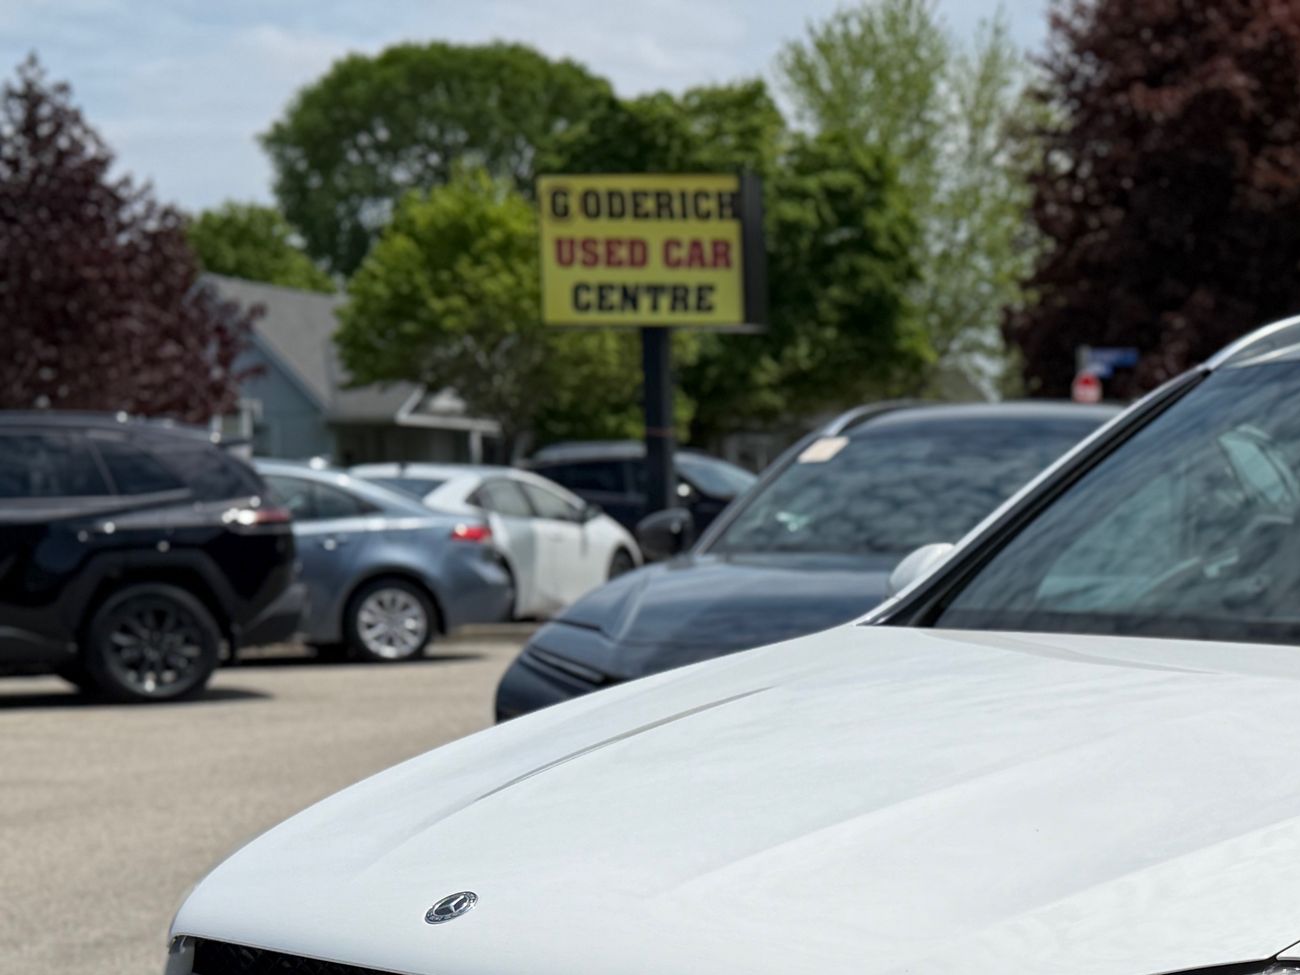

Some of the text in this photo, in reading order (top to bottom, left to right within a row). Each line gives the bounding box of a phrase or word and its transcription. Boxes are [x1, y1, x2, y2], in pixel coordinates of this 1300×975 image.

[556, 238, 732, 269] USED CAR
[573, 283, 715, 312] CENTRE
